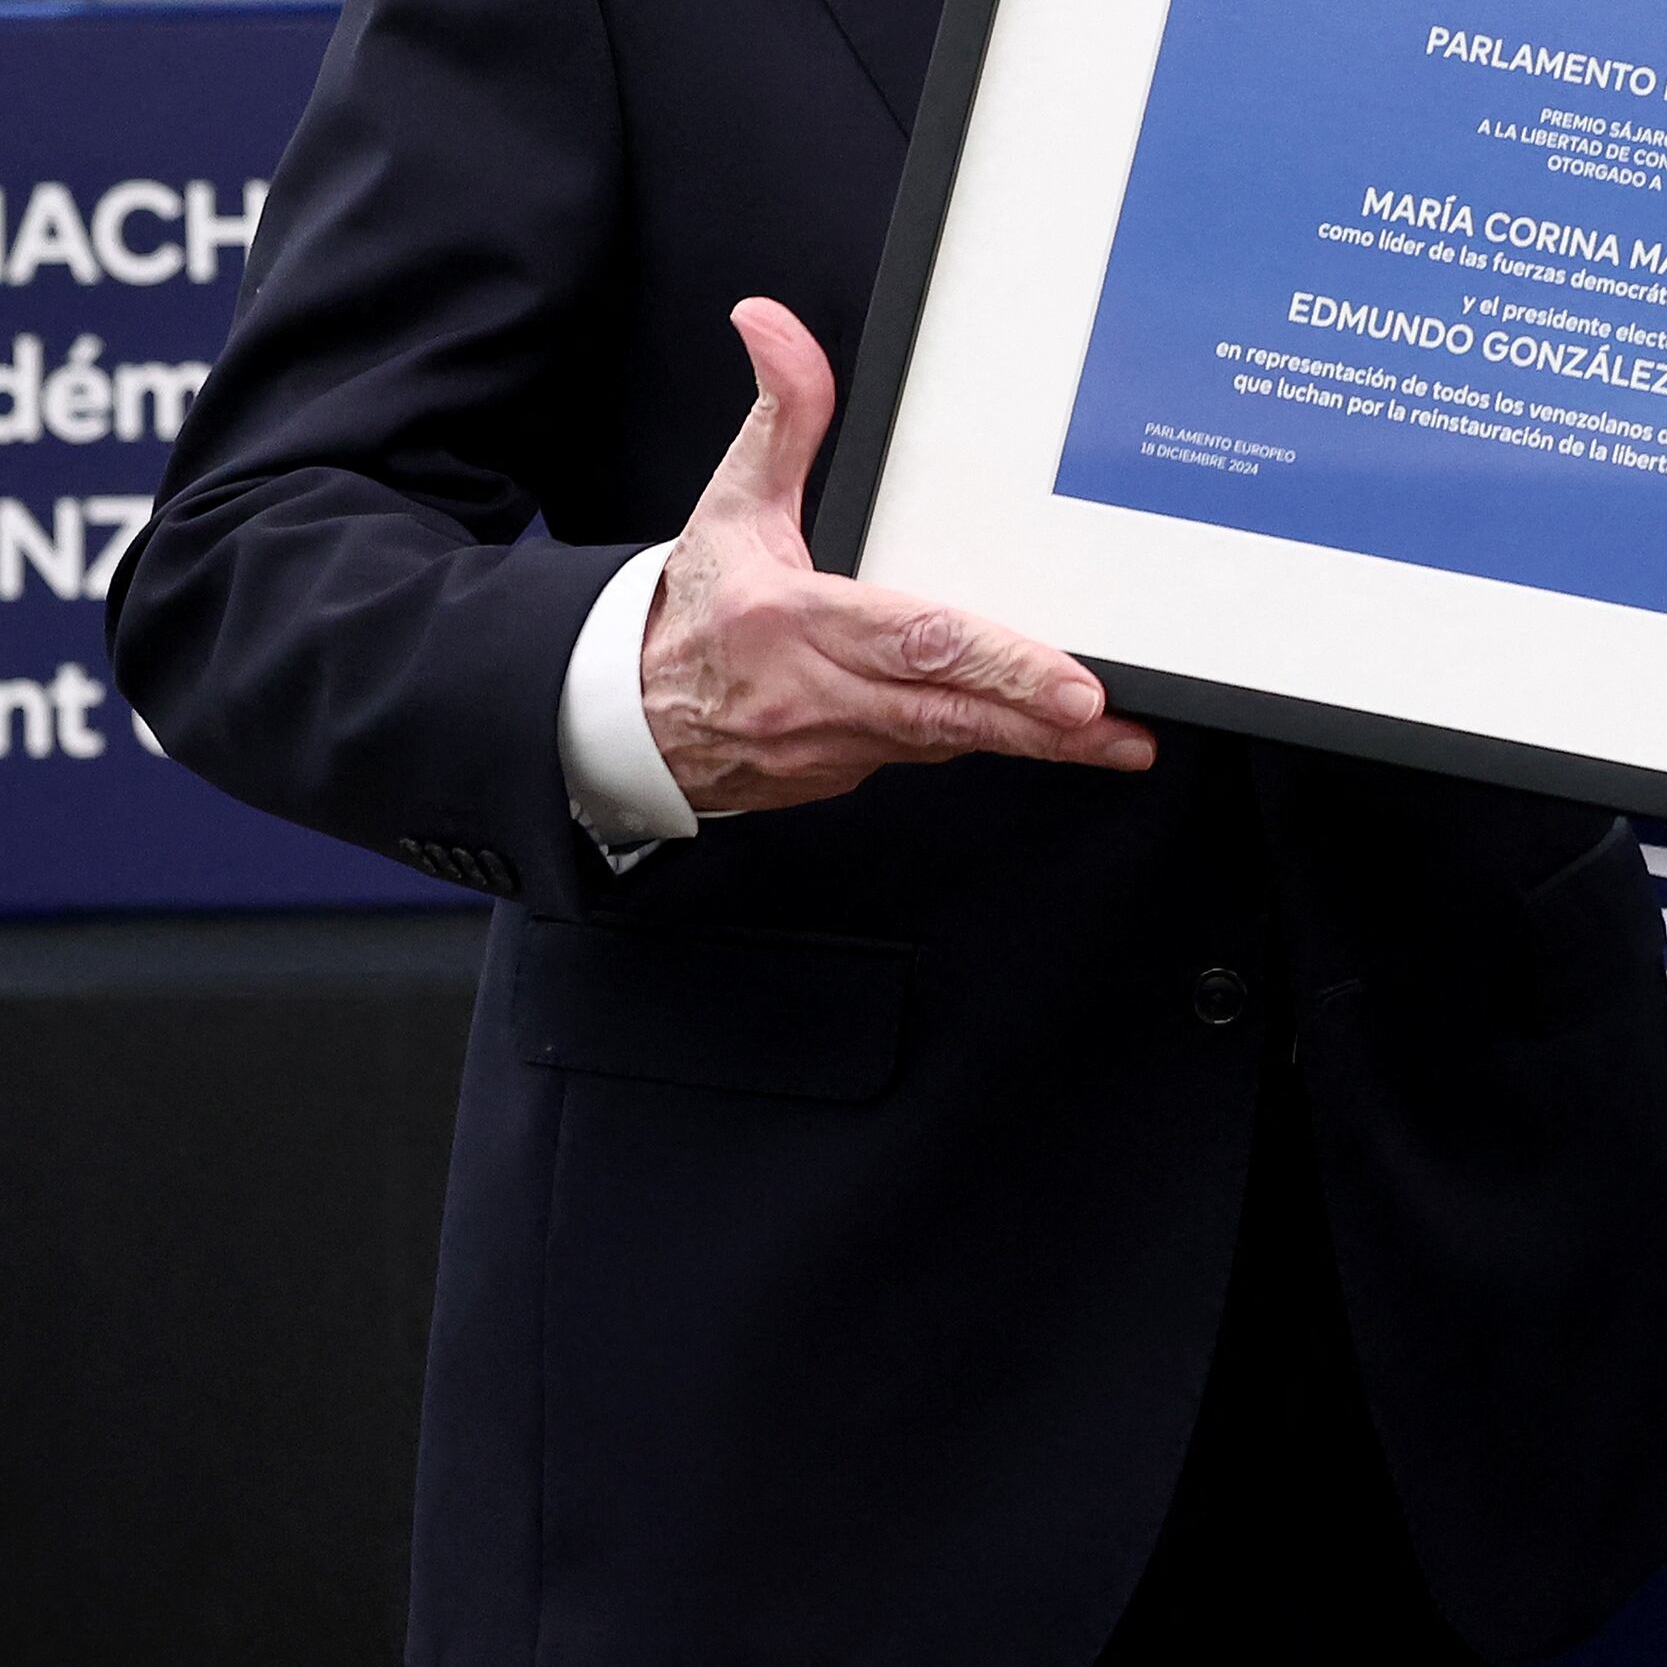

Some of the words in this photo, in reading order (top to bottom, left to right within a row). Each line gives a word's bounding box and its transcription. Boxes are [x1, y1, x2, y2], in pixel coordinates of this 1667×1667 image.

[1425, 25, 1657, 96] PARLAMENTO
[1476, 117, 1491, 136] A
[1493, 120, 1517, 141] LA
[1519, 125, 1603, 156] LIBERTAD
[1605, 142, 1631, 162] DE
[1539, 107, 1607, 135] PREMIO
[1546, 153, 1647, 188] OTORGADO
[1647, 173, 1662, 191] A
[0, 180, 270, 285] ACH
[1317, 221, 1375, 247] como
[1377, 228, 1426, 256] líder
[1427, 239, 1456, 263] de
[1458, 243, 1488, 270] las
[1491, 250, 1566, 285] fuerzas
[1360, 185, 1474, 237] MARÍA
[1483, 210, 1620, 266] CORINA
[1287, 290, 1474, 355] EDMUNDO
[1461, 294, 1477, 315] y
[1478, 294, 1500, 317] el
[1500, 303, 1612, 339] presidente
[1214, 340, 1242, 361] en
[1244, 346, 1397, 391] representación
[1400, 373, 1428, 397] de
[1431, 380, 1491, 409] todos
[1493, 390, 1525, 416] los
[1528, 402, 1654, 441] venezolanos
[1232, 373, 1273, 395] que
[1275, 376, 1344, 410] luchan
[1345, 395, 1385, 417] por
[1386, 398, 1406, 422] la
[1408, 407, 1554, 451] reinstauración
[1557, 433, 1585, 457] de
[1588, 438, 1608, 462] la
[1143, 421, 1232, 451] PARLAMENTO
[1232, 438, 1296, 464] EUROPEO
[1155, 443, 1227, 470] DICIEMBRE
[1227, 458, 1259, 476] 2024
